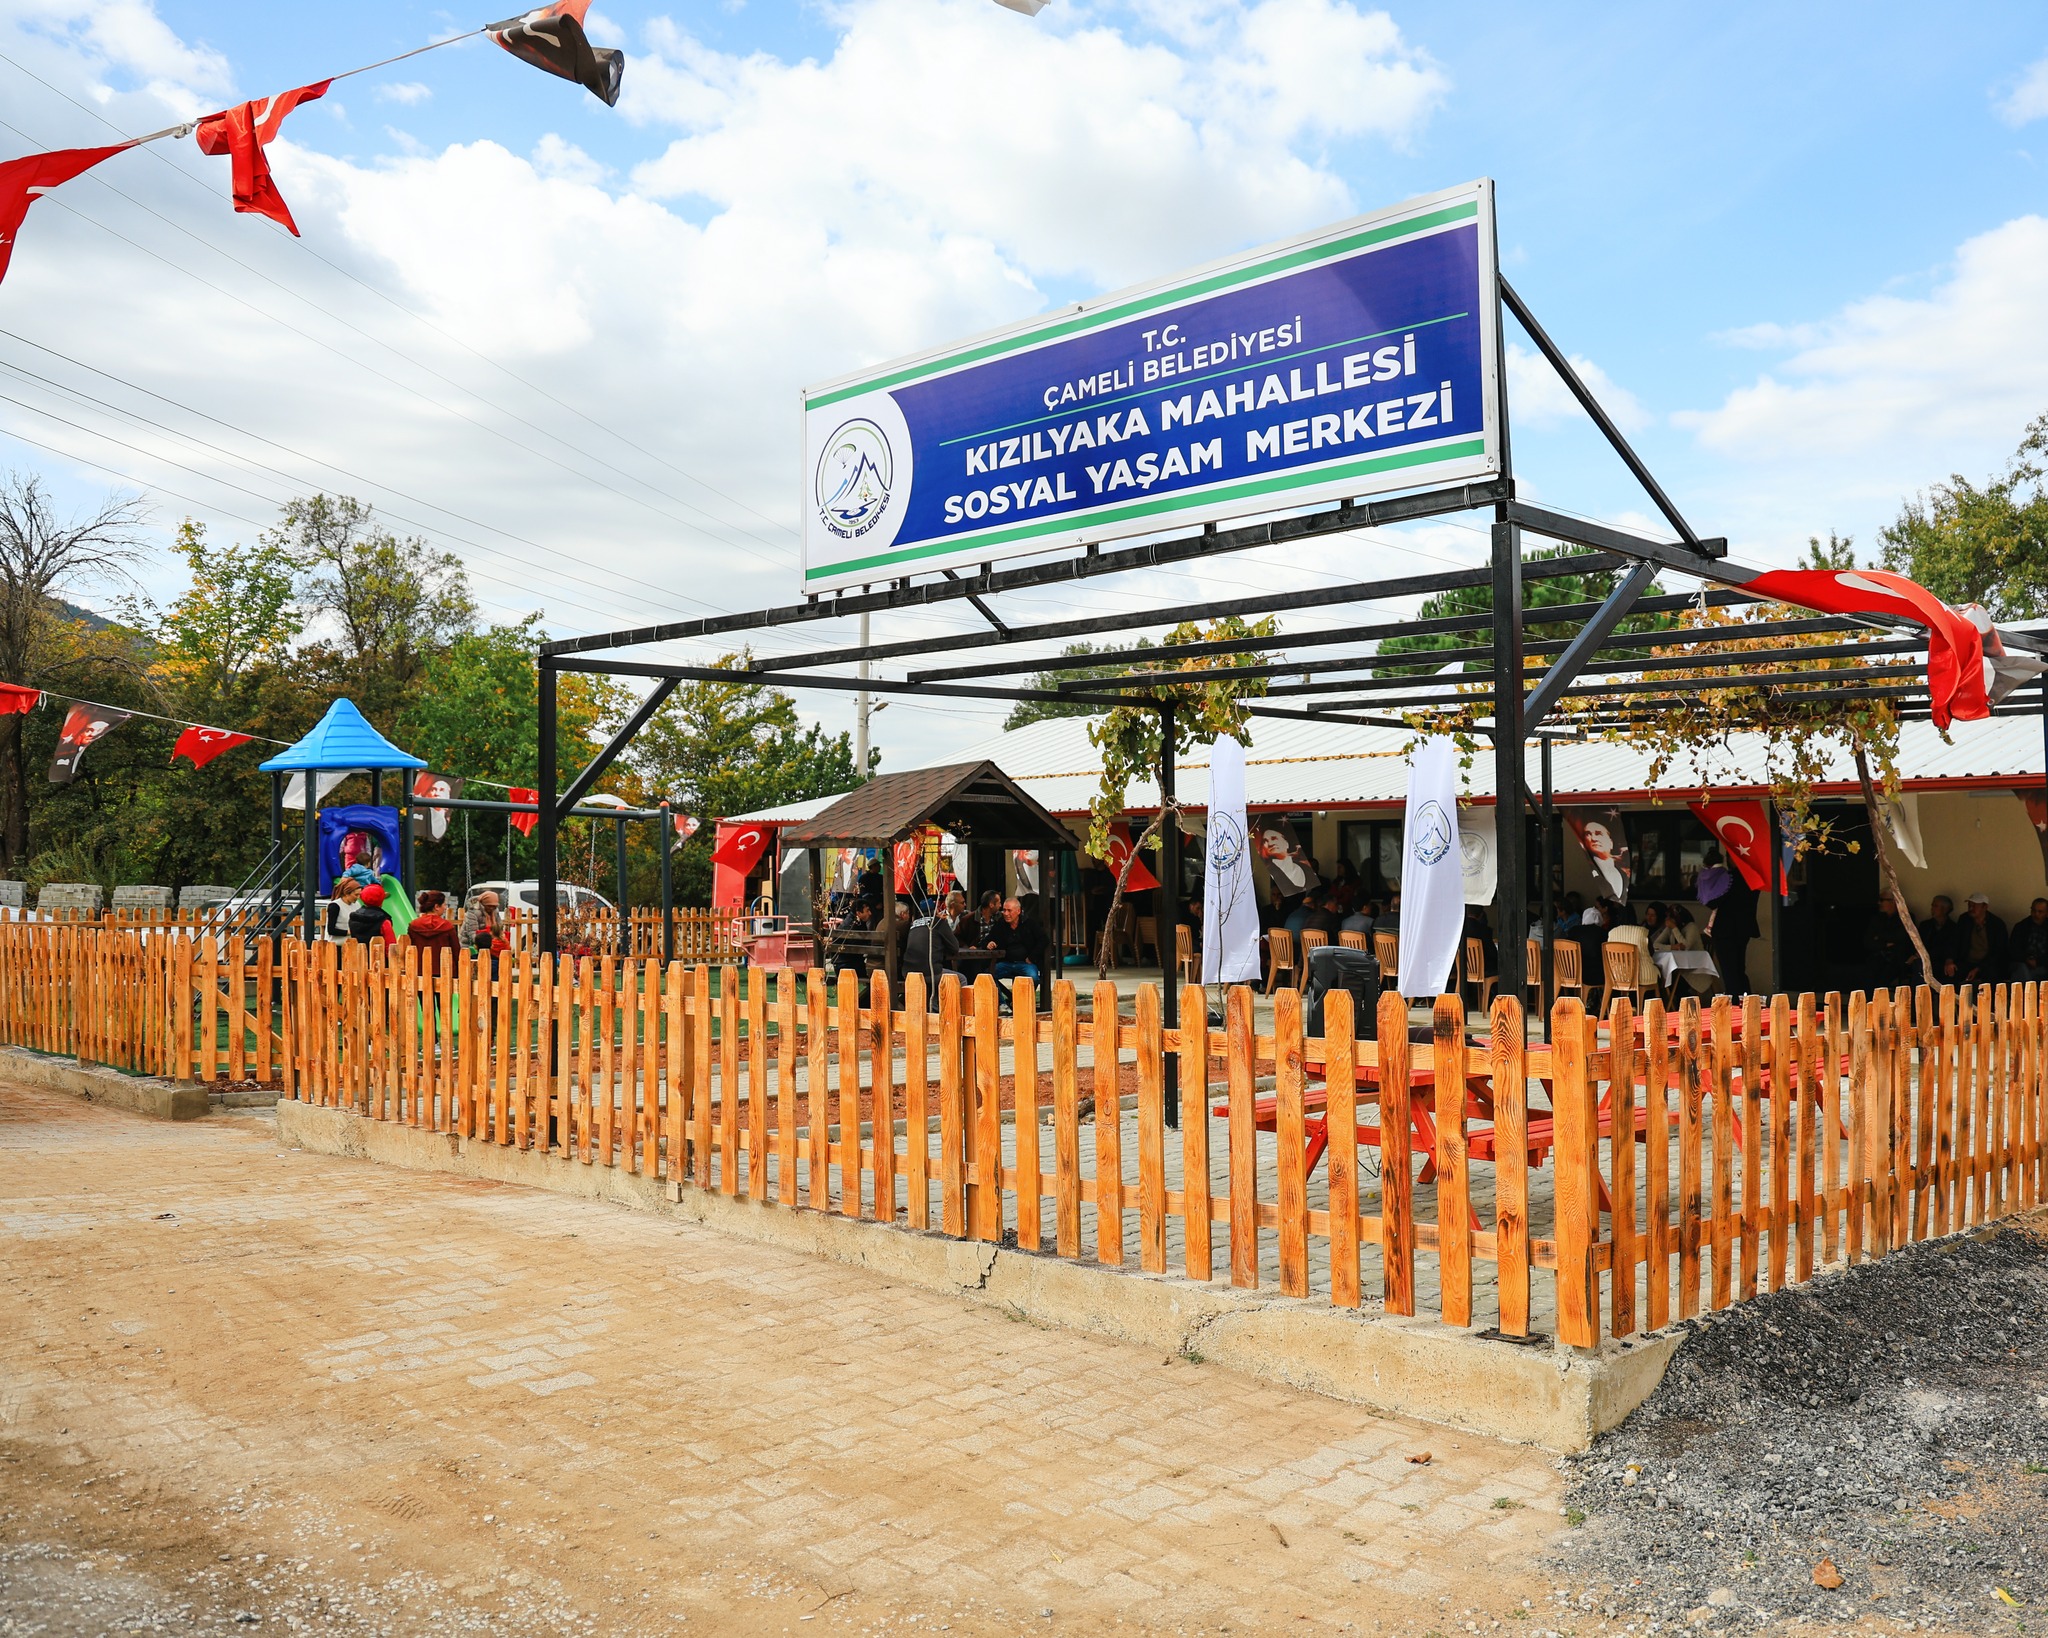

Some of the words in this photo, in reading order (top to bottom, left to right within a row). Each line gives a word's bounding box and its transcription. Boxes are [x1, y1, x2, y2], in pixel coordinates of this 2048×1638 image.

[1044, 362, 1135, 411] ÇAMELİ
[1143, 316, 1302, 383] BELEDİYESİ
[1143, 325, 1187, 352] T.C.
[944, 472, 1077, 524] SOSYAL
[1086, 439, 1223, 493] YAŞAM
[1247, 381, 1454, 462] MERKEZİ
[967, 407, 1150, 476] KIZILYAKA
[1161, 333, 1417, 431] MAHALLESİ
